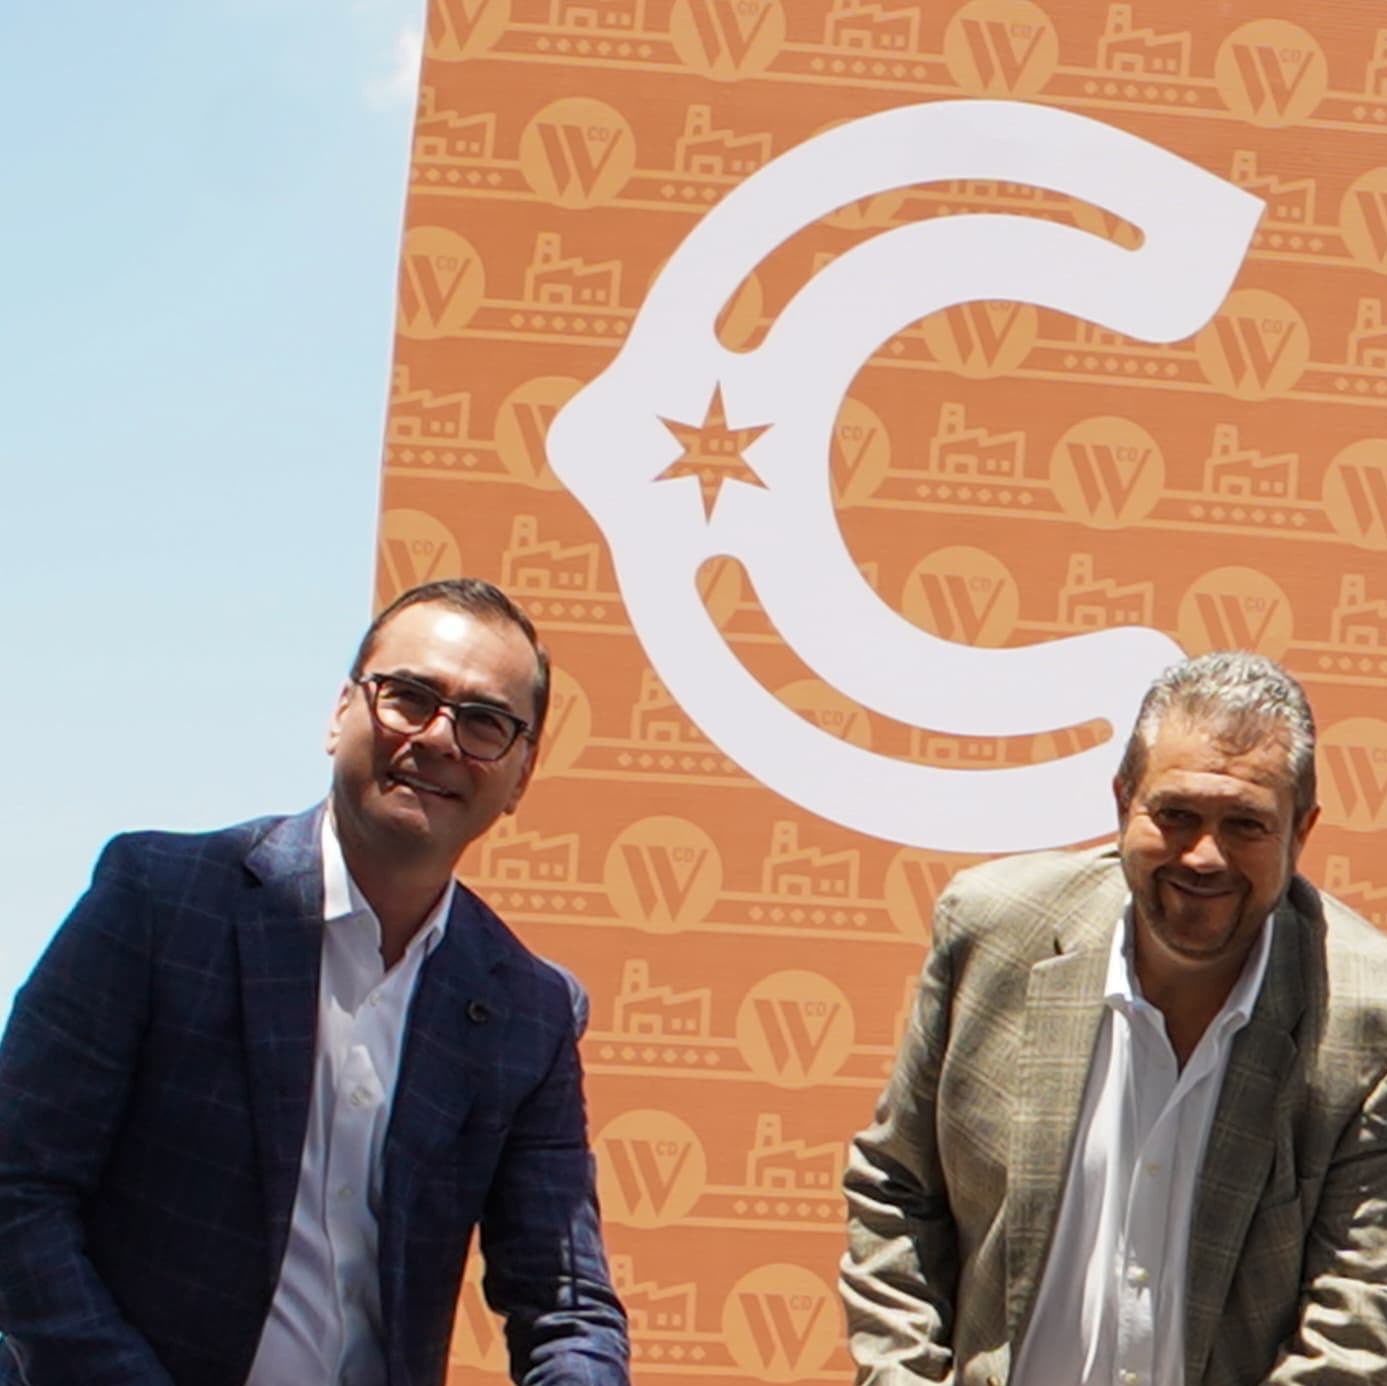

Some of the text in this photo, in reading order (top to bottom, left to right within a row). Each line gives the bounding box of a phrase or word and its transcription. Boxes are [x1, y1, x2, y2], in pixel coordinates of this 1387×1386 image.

[679, 0, 773, 69] W
[960, 19, 1046, 92] W
[1232, 44, 1314, 116] W
[536, 123, 622, 198] W
[1213, 316, 1296, 389] W
[1066, 442, 1152, 518] W
[919, 573, 1005, 647] W
[620, 844, 708, 922] W
[754, 999, 840, 1076] W
[604, 1138, 691, 1216] W
[738, 1293, 826, 1370] W
